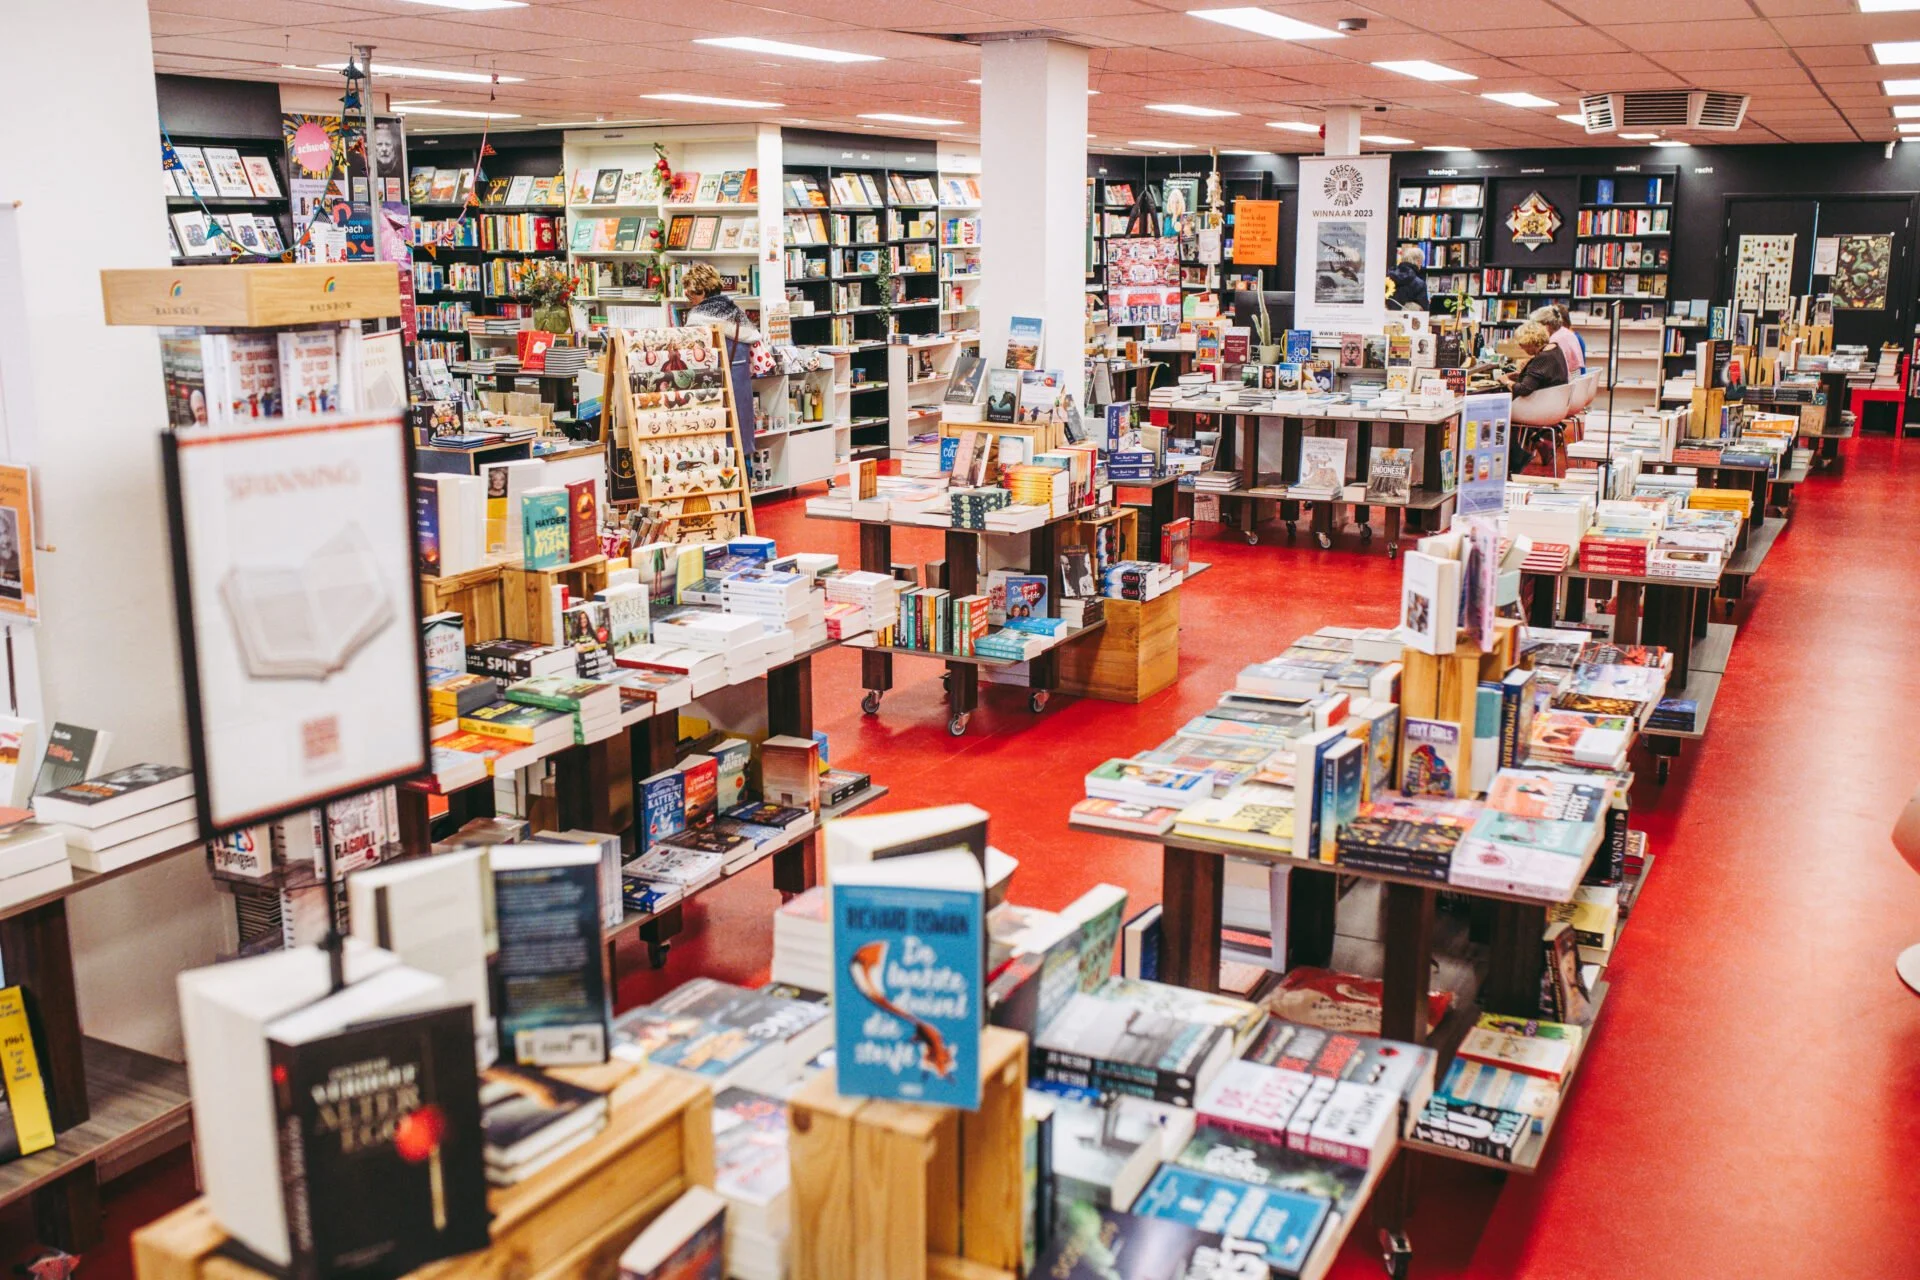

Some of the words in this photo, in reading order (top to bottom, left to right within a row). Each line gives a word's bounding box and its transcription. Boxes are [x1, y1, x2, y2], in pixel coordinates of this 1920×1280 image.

[297, 141, 330, 154] schwob
[1169, 171, 1201, 179] gezondheid
[1695, 165, 1714, 174] recht
[1323, 177, 1333, 200] LIBRIS
[1330, 164, 1364, 200] GESCHIEDENIS
[1334, 199, 1354, 207] PRIJS
[1312, 209, 1352, 217] WINNAAR
[1354, 209, 1373, 217] 2023
[343, 224, 364, 234] bach
[155, 307, 200, 316] RAINBOW
[309, 301, 352, 312] RAINBOW
[535, 516, 567, 528] HAYDER
[1122, 588, 1138, 596] ATLAS
[615, 598, 641, 612] KATE
[613, 609, 646, 624] MOSSE
[487, 656, 517, 674] SPIN
[724, 752, 735, 761] JET
[648, 789, 681, 810] KATTEN
[334, 831, 377, 861] RAGDOLL
[223, 849, 258, 870] jongen
[846, 905, 907, 933] RICHARD
[911, 908, 969, 937] OSMAN
[902, 935, 937, 965] De
[886, 960, 968, 993] laatste
[1447, 1110, 1494, 1139] U
[1416, 1126, 1471, 1151] THUG
